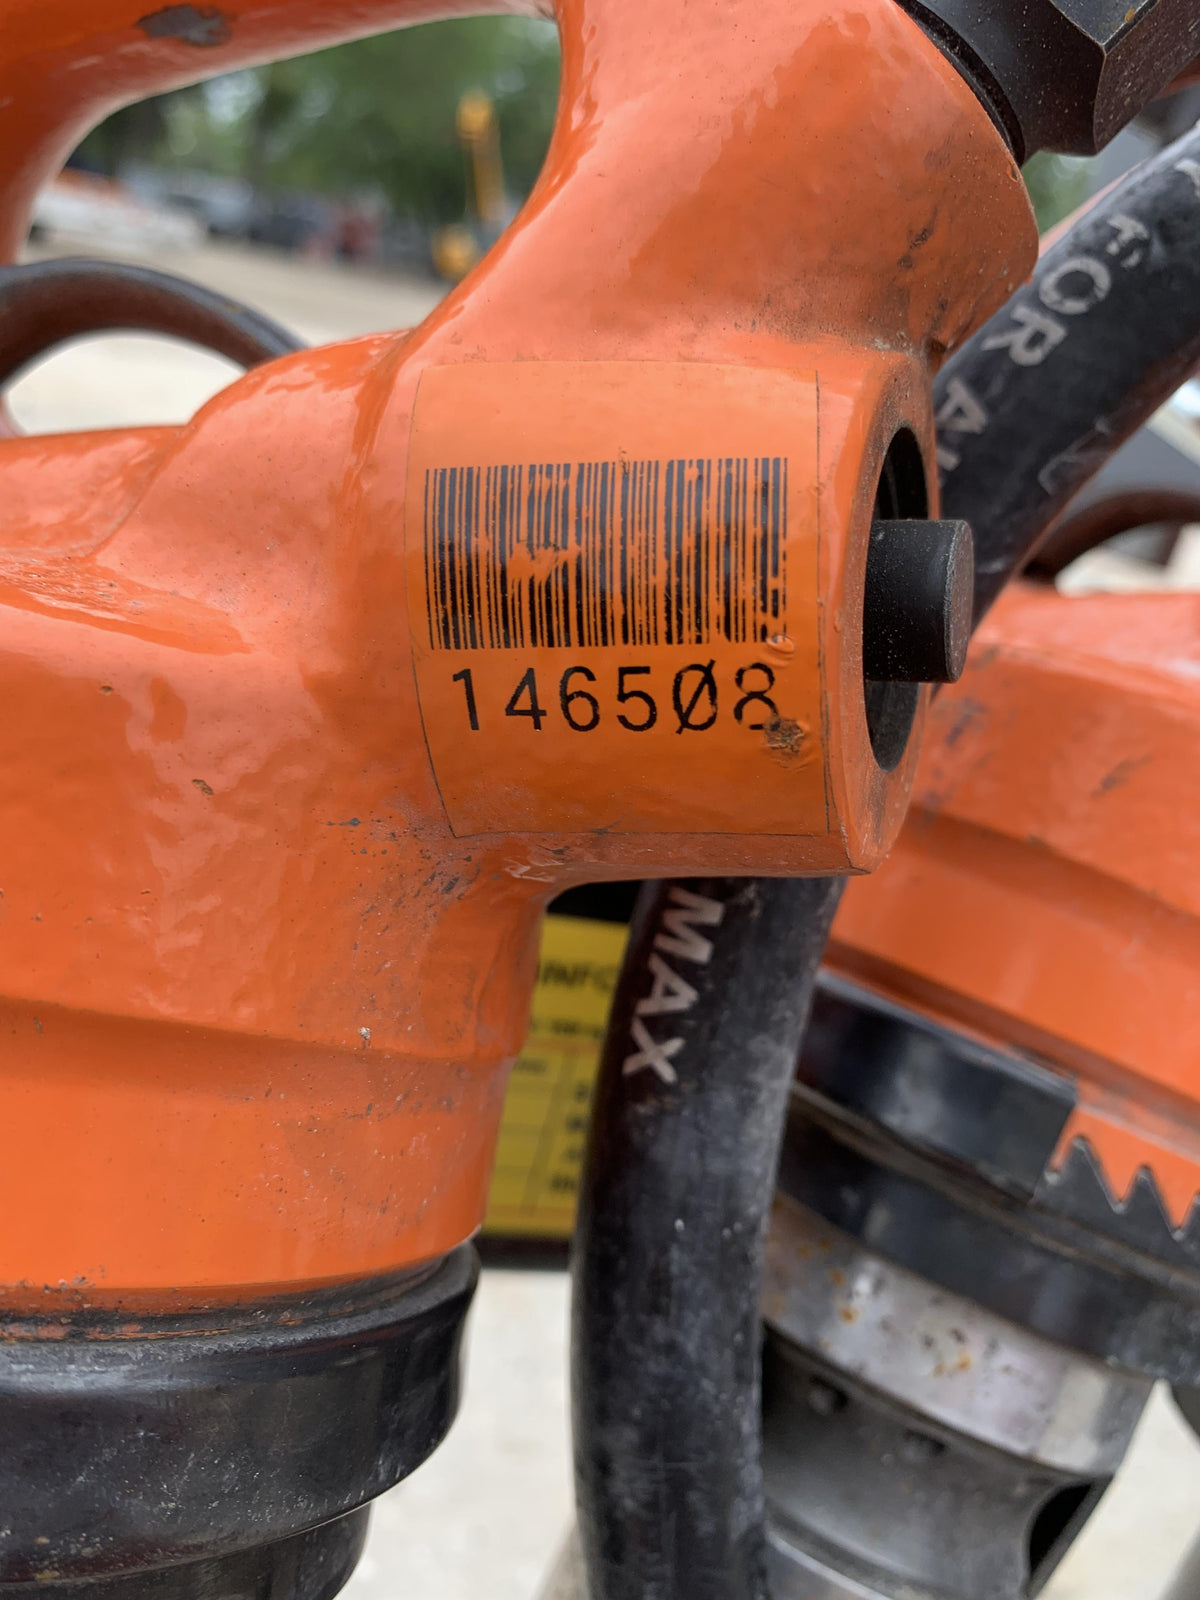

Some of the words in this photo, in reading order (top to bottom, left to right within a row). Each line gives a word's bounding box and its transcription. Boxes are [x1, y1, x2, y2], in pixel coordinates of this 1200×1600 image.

[981, 215, 1150, 367] FOR
[451, 659, 779, 735] 146508
[621, 885, 725, 1084] MAX
